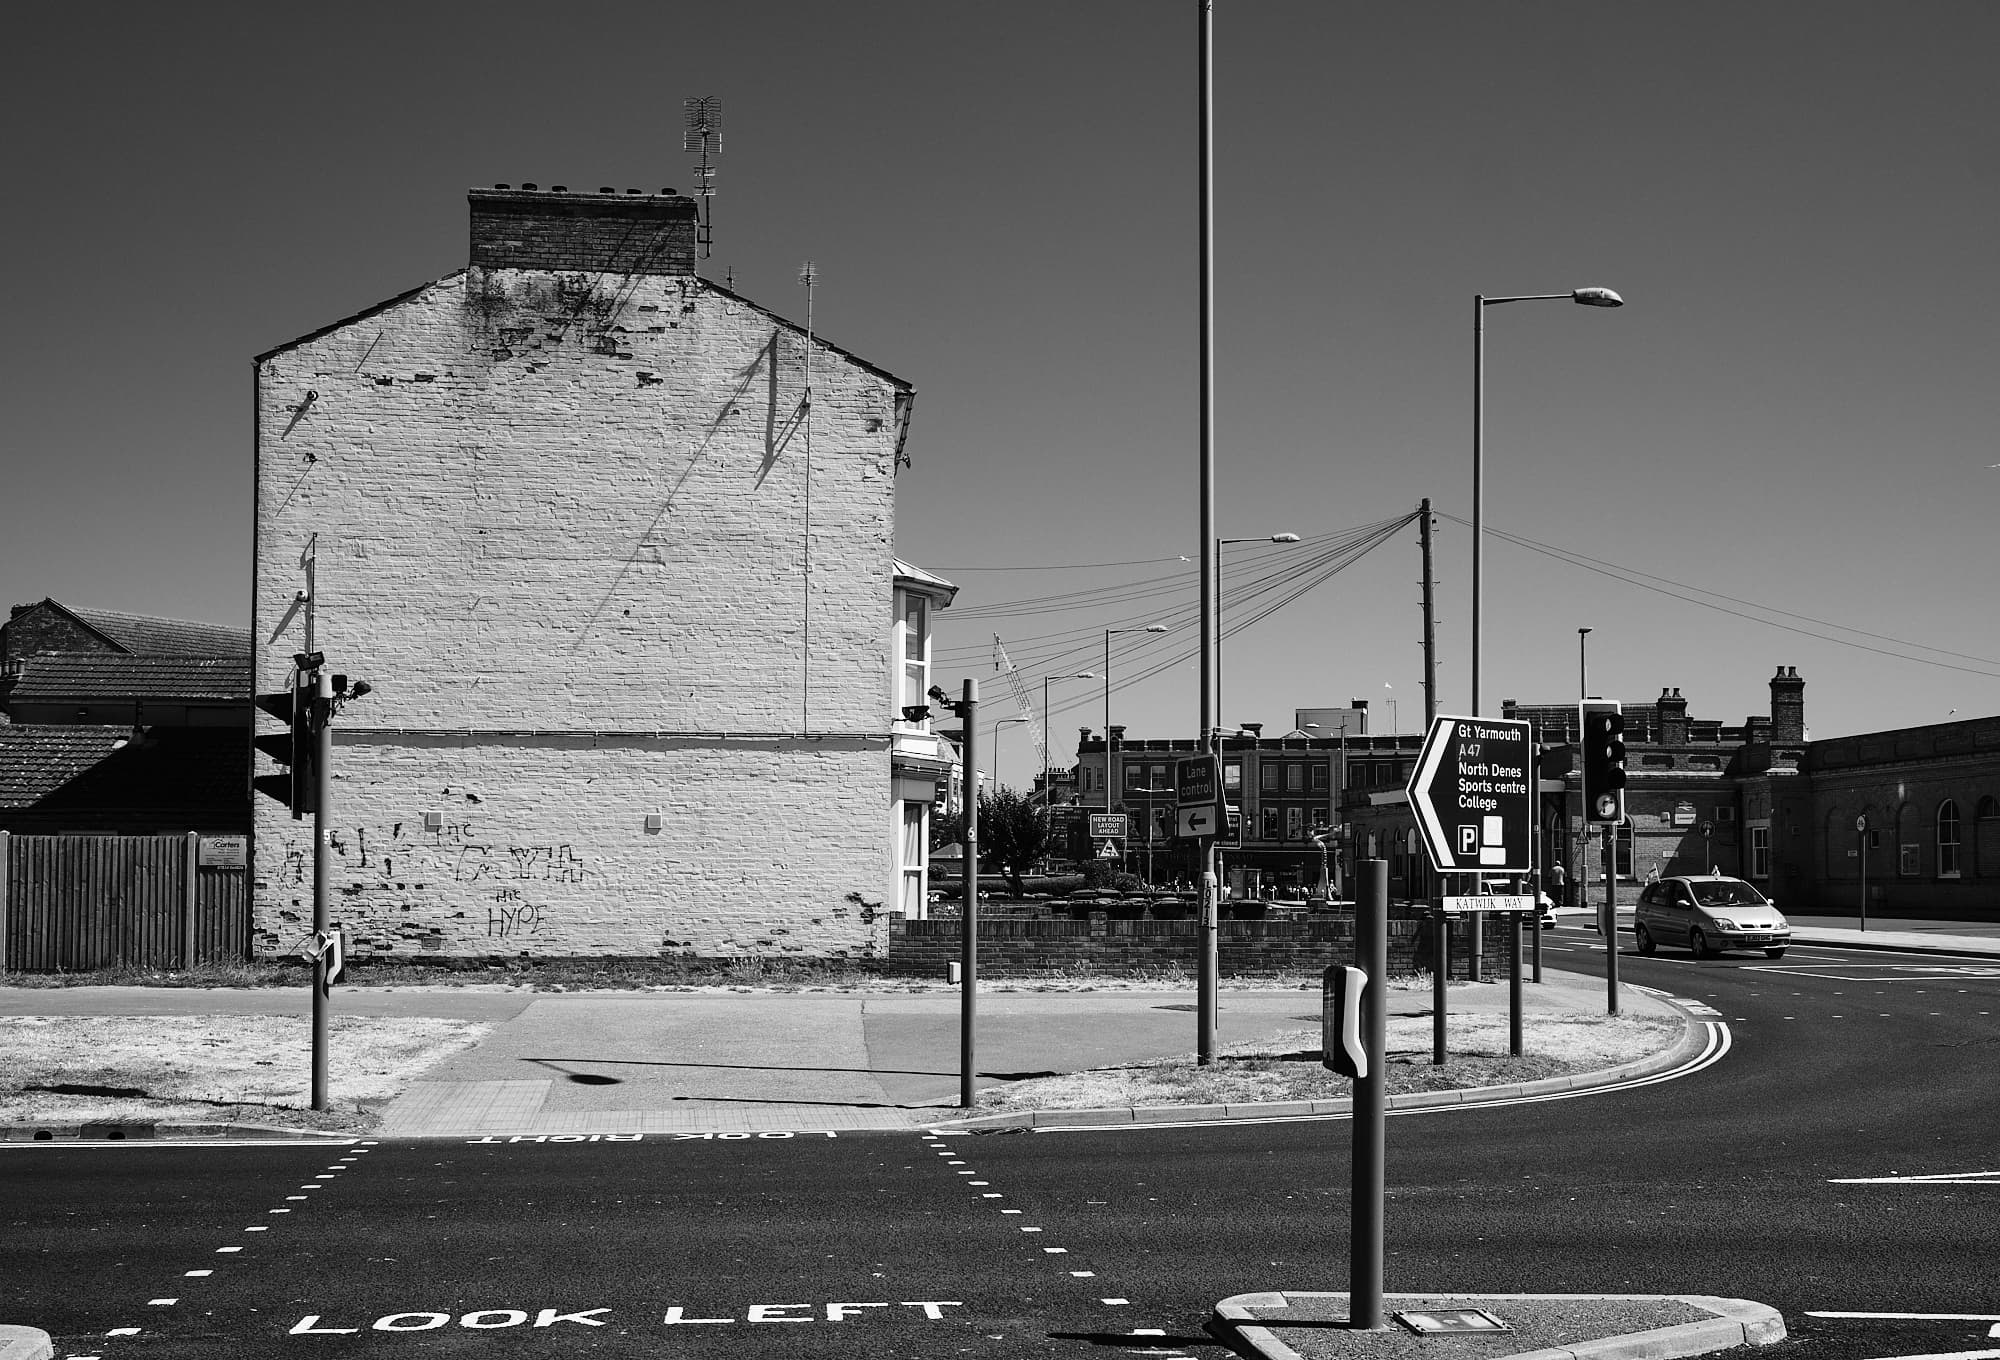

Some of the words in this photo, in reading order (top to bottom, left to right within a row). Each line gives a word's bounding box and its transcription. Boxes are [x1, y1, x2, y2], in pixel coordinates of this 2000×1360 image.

[1458, 724, 1472, 738] Gt
[1474, 725, 1521, 741] Yarmouth
[1186, 767, 1206, 779] Lane
[1459, 762, 1489, 776] North
[1491, 763, 1522, 778] Denes
[1181, 780, 1212, 796] control
[1458, 778, 1492, 794] Sports
[1494, 781, 1526, 794] centre
[1458, 795, 1498, 812] College
[323, 829, 331, 840] 5
[967, 826, 975, 838] 6
[1462, 828, 1475, 852] P
[1504, 898, 1523, 909] WAY
[488, 904, 548, 938] HYPE
[465, 1133, 644, 1144] RIGHT
[671, 1129, 838, 1142] LOOK
[289, 1307, 613, 1336] LOOK
[664, 1300, 963, 1325] LEFT
